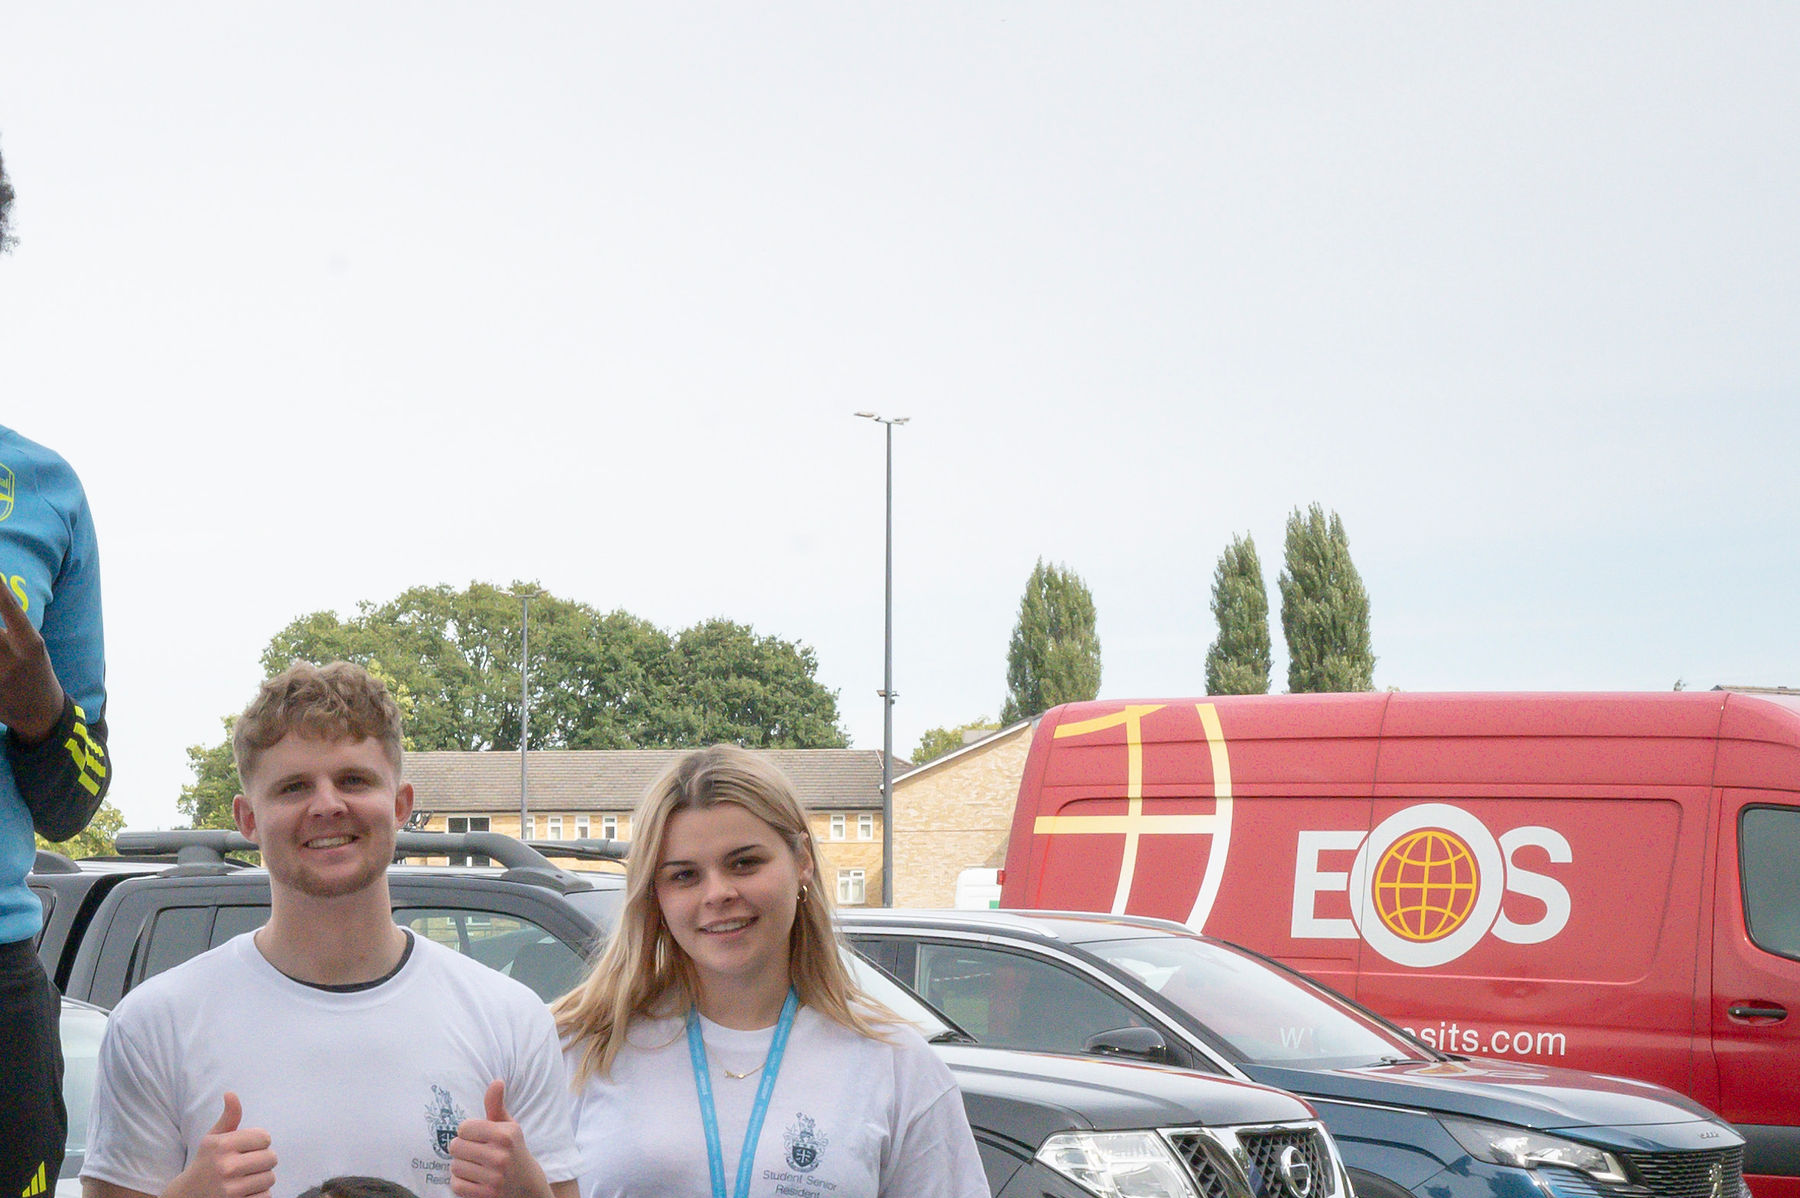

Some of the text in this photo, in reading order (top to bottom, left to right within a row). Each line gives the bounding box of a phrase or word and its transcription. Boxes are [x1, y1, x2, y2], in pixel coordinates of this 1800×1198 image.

[1290, 802, 1573, 968] EOS
[762, 1169, 837, 1191] Student Senior
